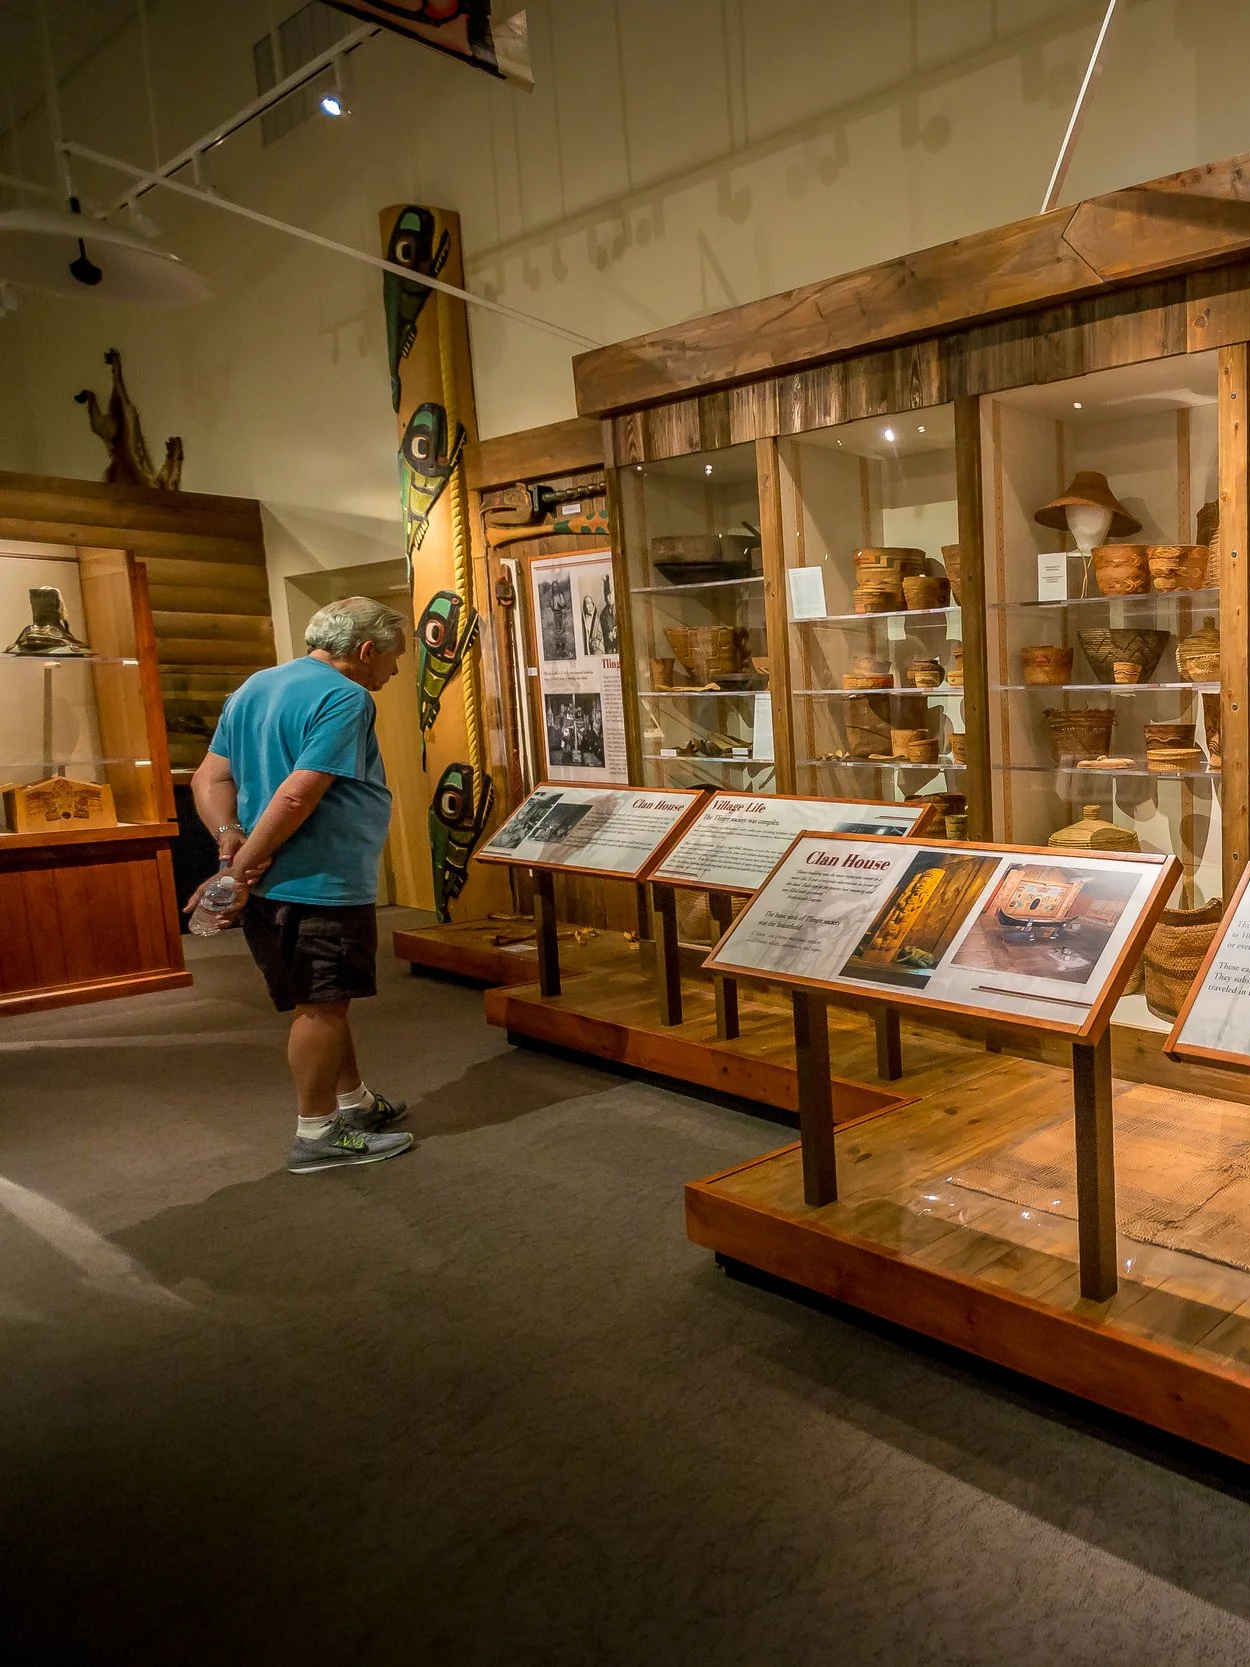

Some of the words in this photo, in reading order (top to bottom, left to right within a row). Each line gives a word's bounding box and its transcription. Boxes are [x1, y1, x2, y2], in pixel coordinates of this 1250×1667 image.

[632, 799, 652, 809] Clan
[654, 801, 684, 812] House
[711, 800, 744, 814] Village
[746, 802, 766, 813] Life
[806, 851, 839, 866] Clan
[841, 854, 891, 871] House
[1219, 961, 1239, 971] These
[1214, 972, 1232, 982] They
[1208, 984, 1237, 995] traveled
